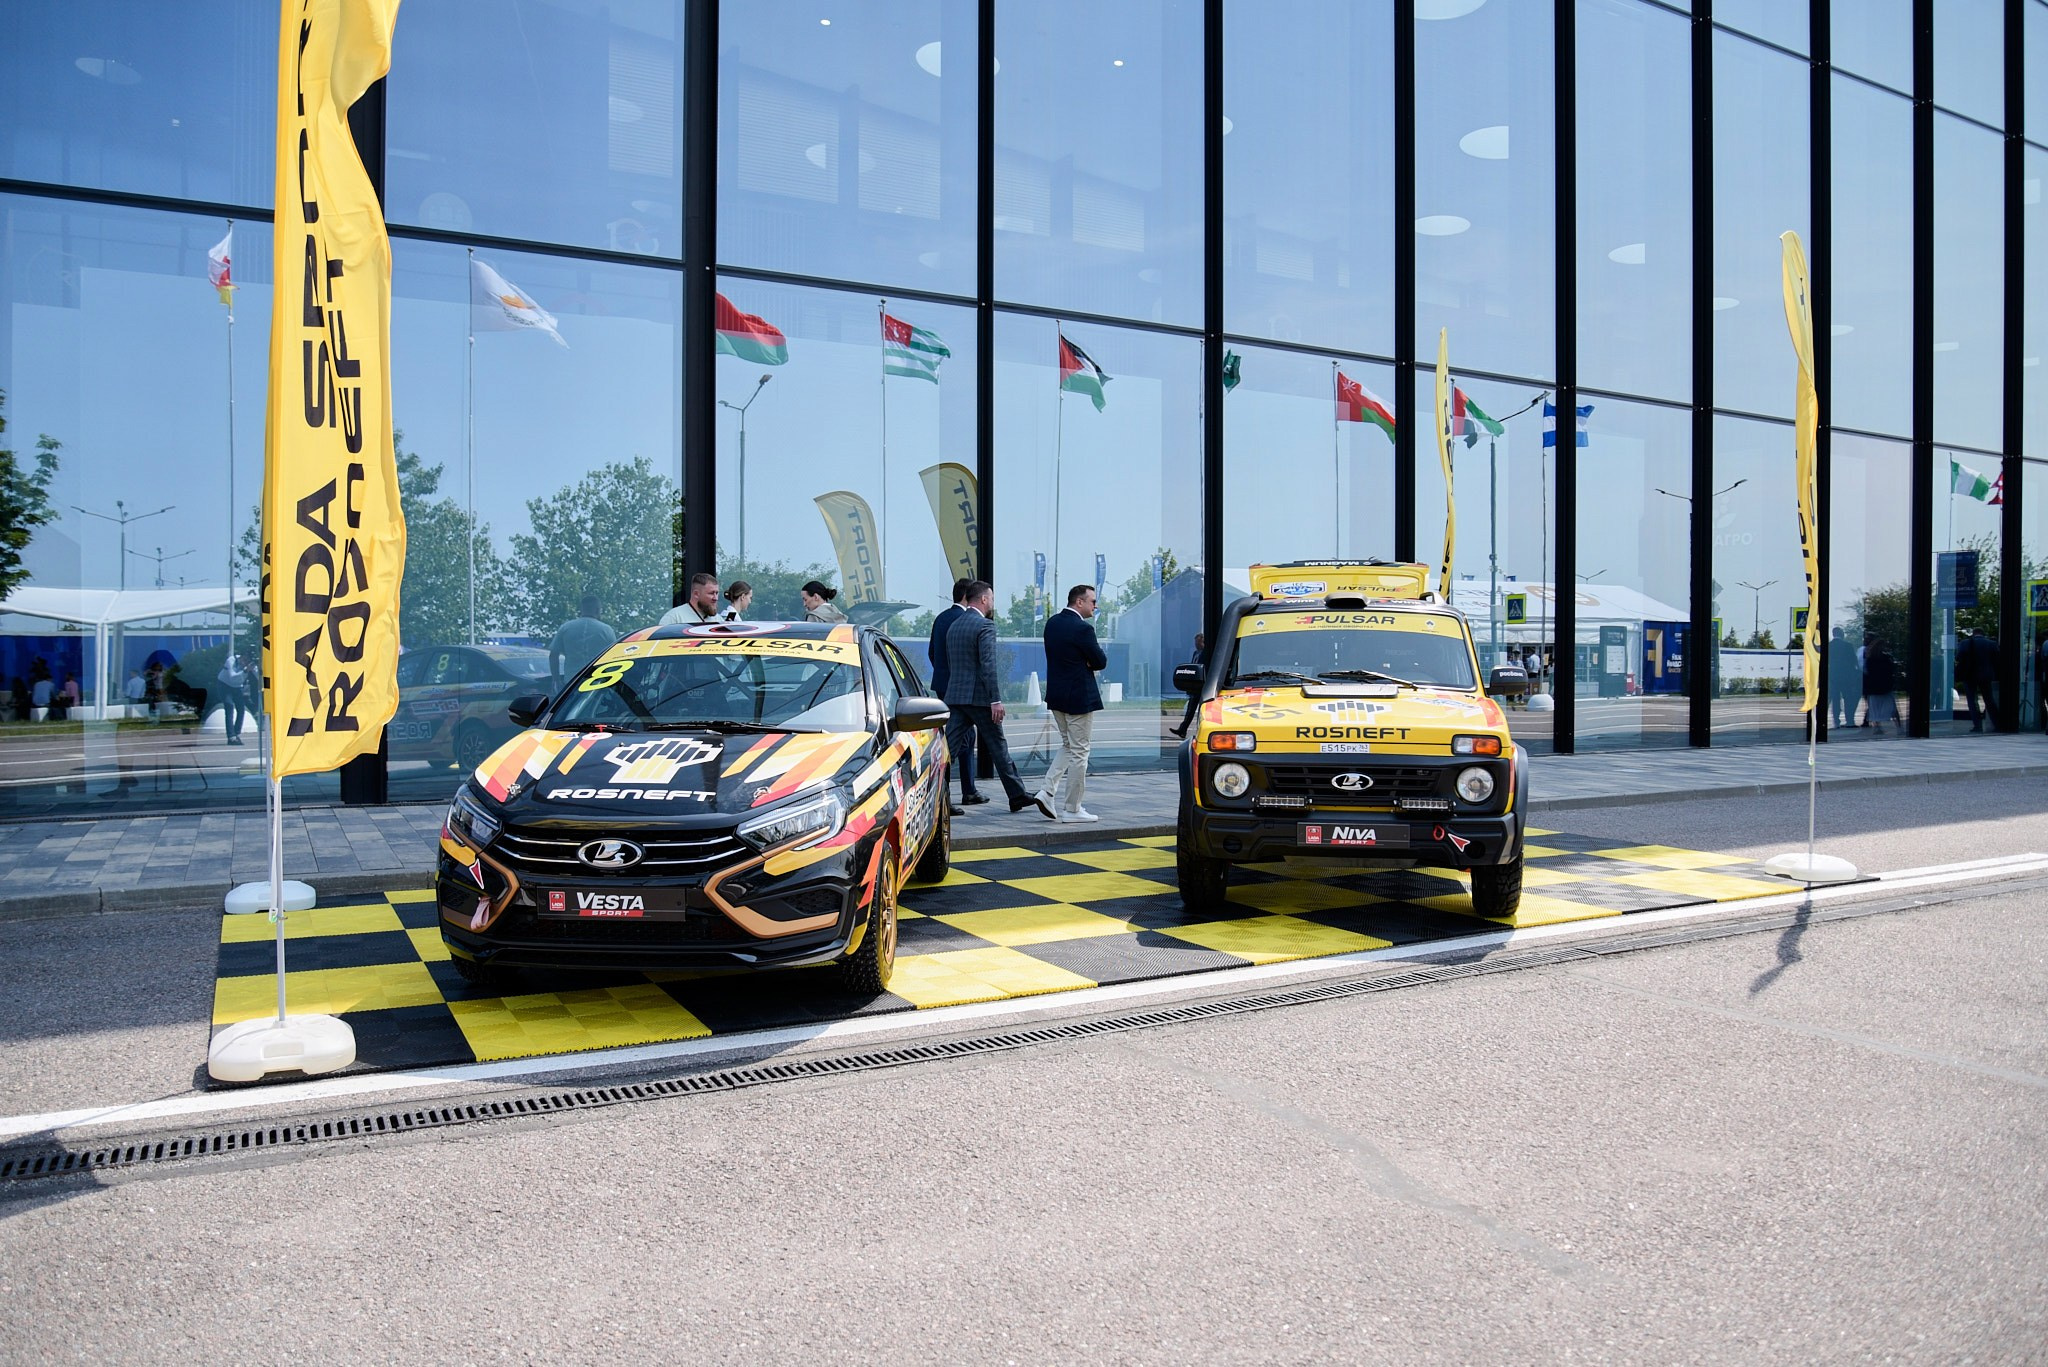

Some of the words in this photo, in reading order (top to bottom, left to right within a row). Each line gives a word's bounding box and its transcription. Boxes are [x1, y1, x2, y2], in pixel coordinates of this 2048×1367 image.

[287, 477, 337, 737] LADA
[1311, 615, 1396, 625] PULSAR
[694, 638, 844, 655] PULSAR
[578, 660, 635, 692] 8
[1296, 726, 1411, 739] ROSNEFT
[546, 788, 717, 802] ROSNEFT
[1332, 826, 1377, 840] NIVA
[576, 892, 645, 910] VESTA
